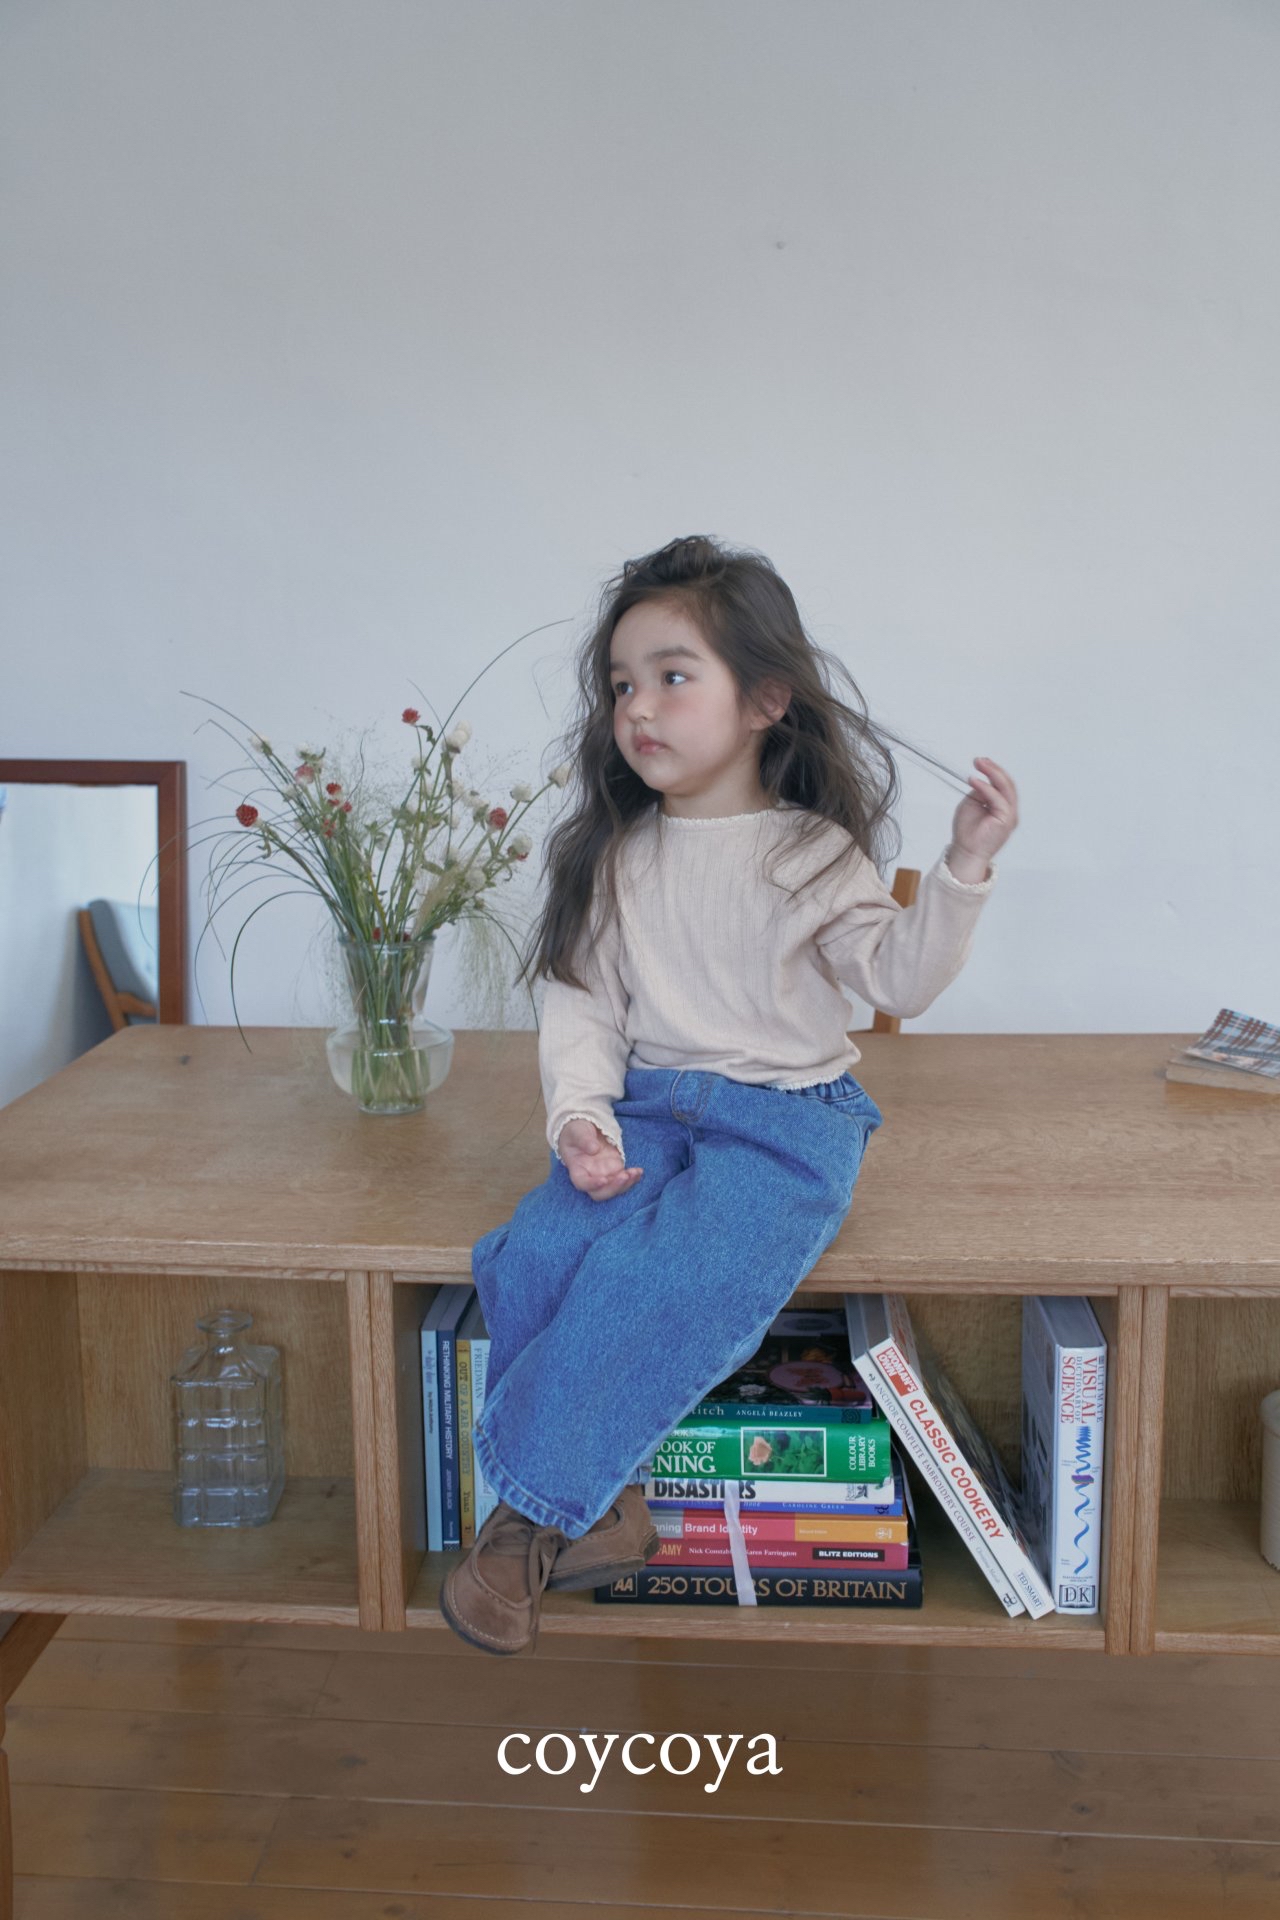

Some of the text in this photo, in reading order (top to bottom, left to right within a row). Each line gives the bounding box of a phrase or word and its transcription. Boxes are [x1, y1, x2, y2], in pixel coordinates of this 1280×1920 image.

[459, 1361, 468, 1382] OUT
[474, 1347, 483, 1399] FRIEDMAN
[878, 1354, 898, 1377] OWN
[884, 1347, 918, 1394] WOMAN'S
[442, 1340, 453, 1459] RETHINKING MILITARY HISTORY
[460, 1383, 469, 1396] OF
[1060, 1355, 1077, 1424] SCIENCE
[1074, 1356, 1083, 1422] DICTIONARY OF
[1081, 1356, 1098, 1424] VISUAL
[1096, 1365, 1105, 1424] ULTIMATE
[461, 1408, 469, 1428] FAR
[690, 1405, 725, 1415] titch
[461, 1430, 471, 1475] COUNTRY
[656, 1441, 716, 1453] OOK OF
[848, 1435, 876, 1471] COLOUR LIBRARY BOOKS
[652, 1455, 716, 1473] NING
[875, 1382, 977, 1542] ANCHOR COMPLETE EMBROIDERY COURSE
[909, 1398, 1005, 1539] CLASSIC COOKERY
[654, 1480, 756, 1499] DISASTS
[684, 1523, 716, 1533] Brand
[719, 1523, 758, 1535] Idtity
[657, 1544, 682, 1556] AMY
[763, 1549, 798, 1557] Farrington
[818, 1550, 879, 1559] BLITZ EDITIONS
[614, 1577, 634, 1592] AA
[648, 1576, 908, 1600] 250 TOUS OF BRITAIN
[1017, 1571, 1043, 1608] TED SMART
[1063, 1586, 1091, 1603] DK
